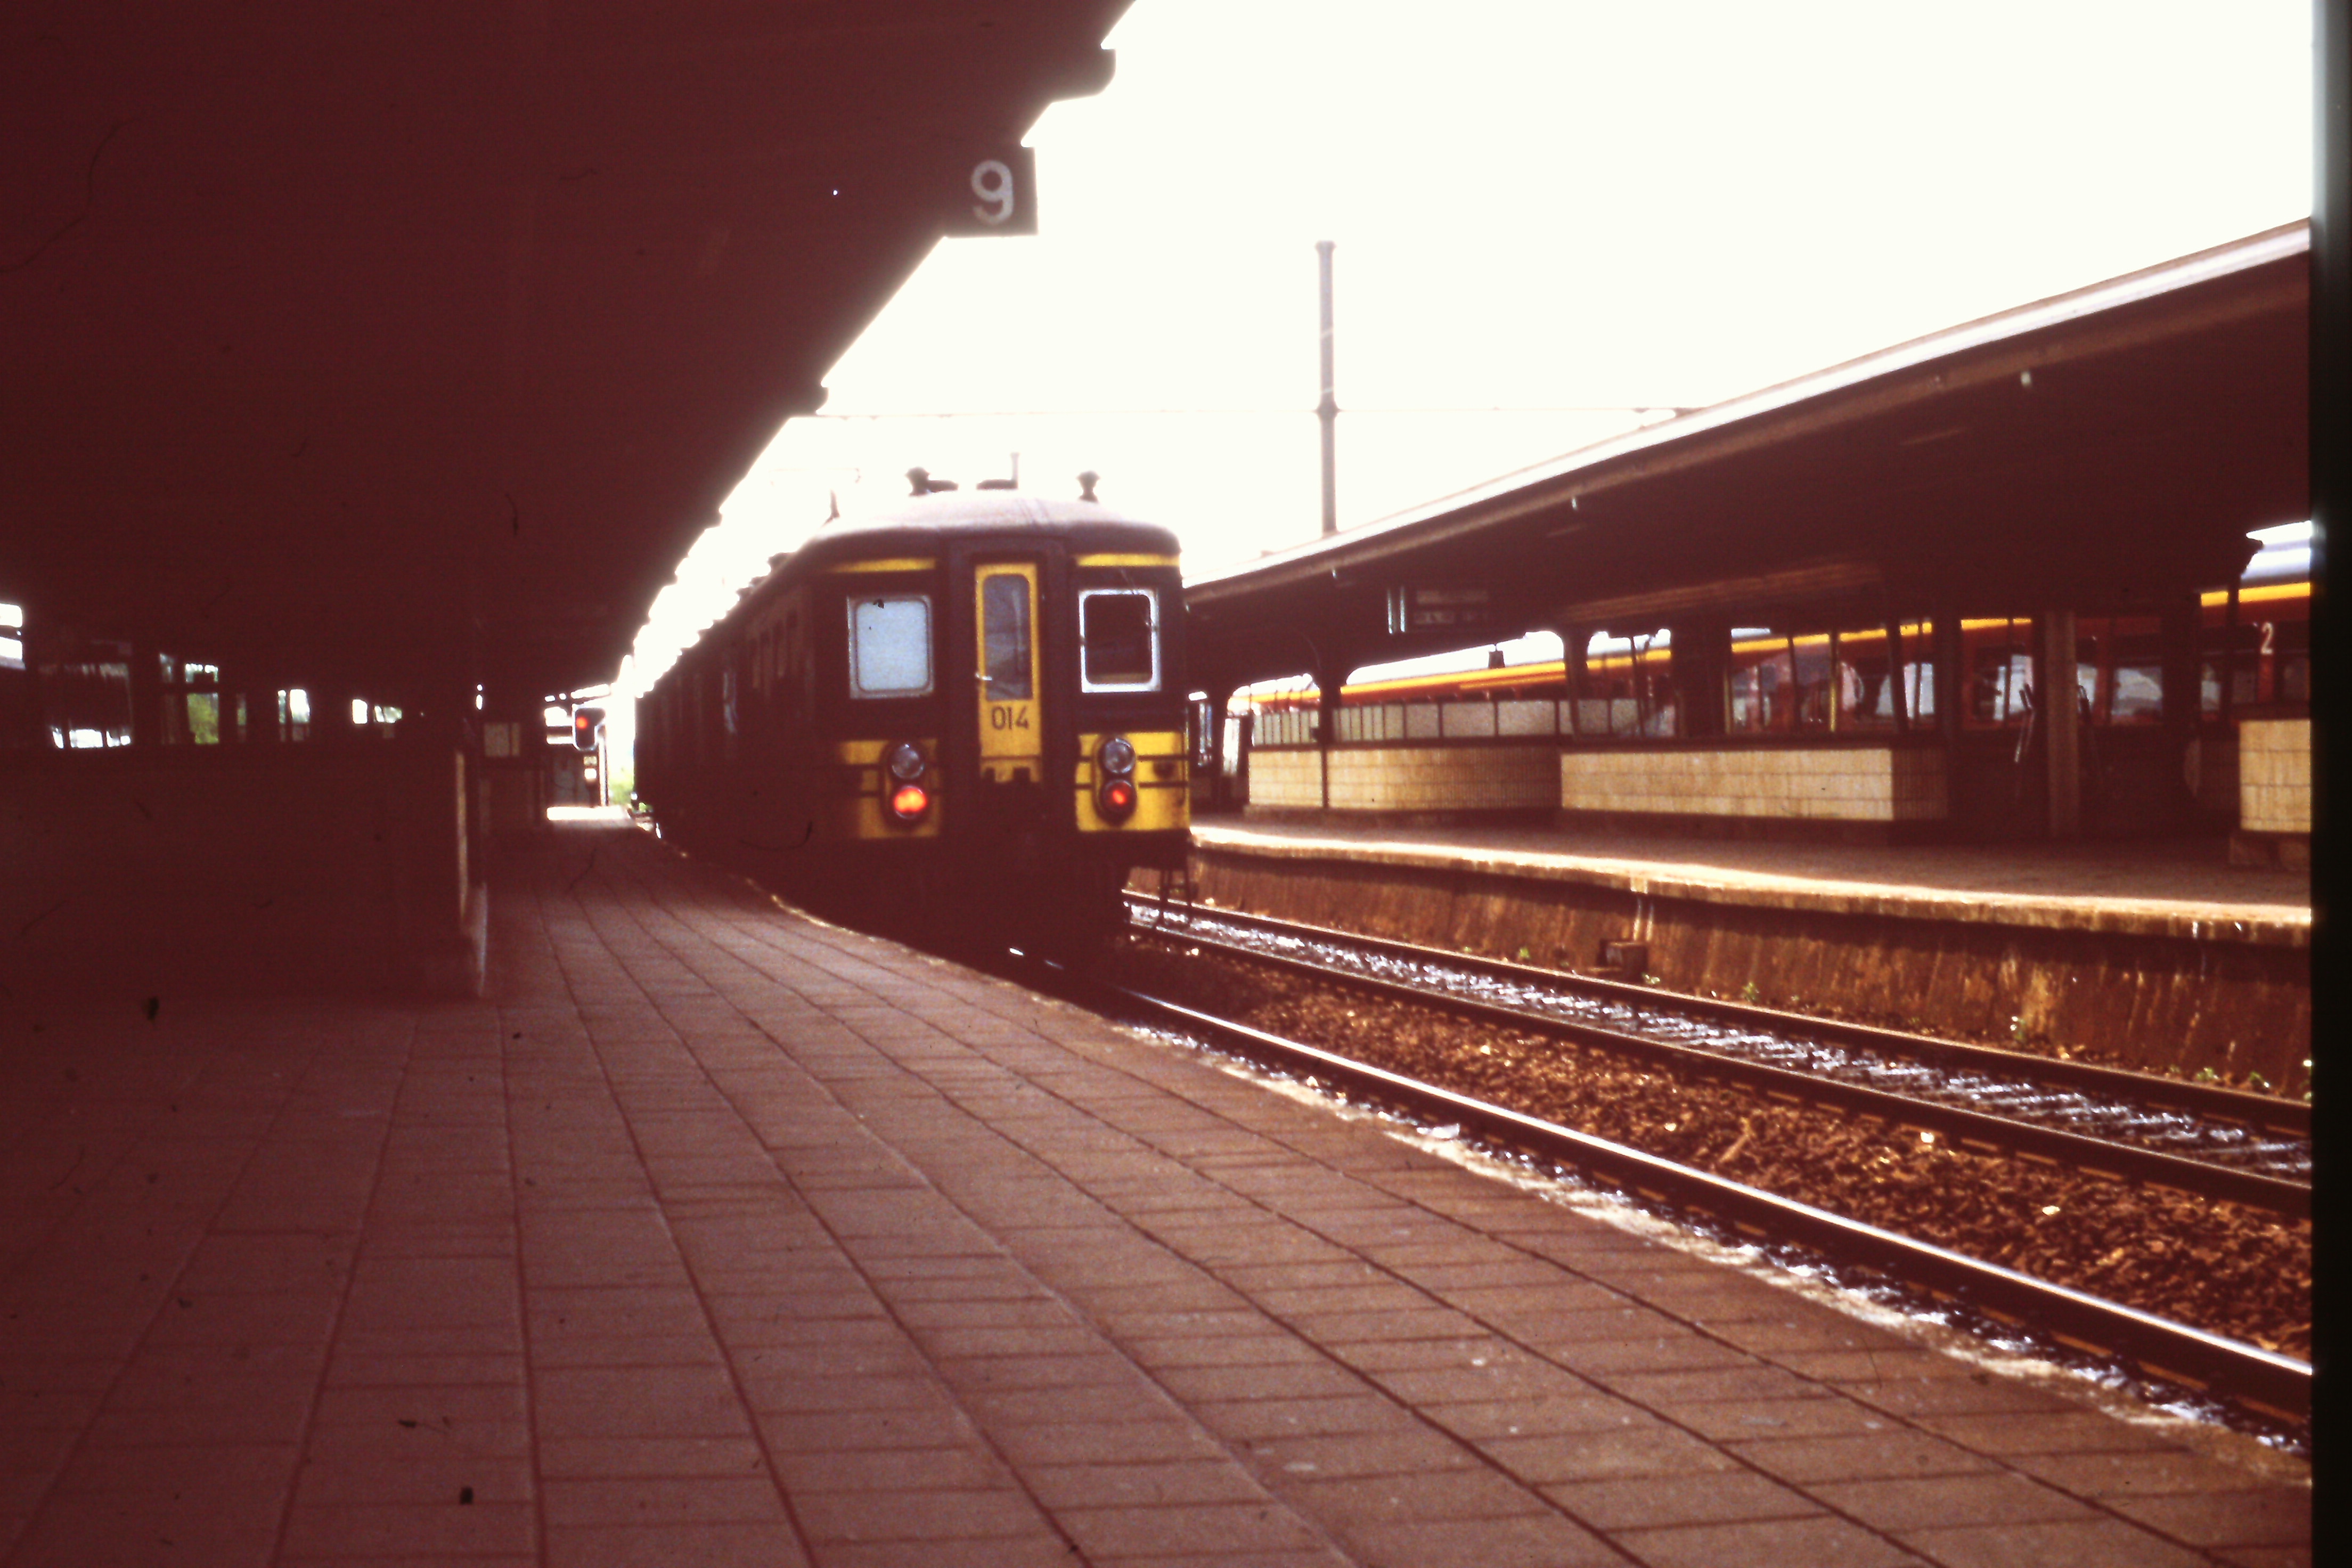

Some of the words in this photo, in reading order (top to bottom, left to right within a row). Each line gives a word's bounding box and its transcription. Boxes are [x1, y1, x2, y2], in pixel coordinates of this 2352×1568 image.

[971, 160, 1014, 225] 9
[2260, 622, 2274, 655] 2
[991, 705, 1029, 730] 014
